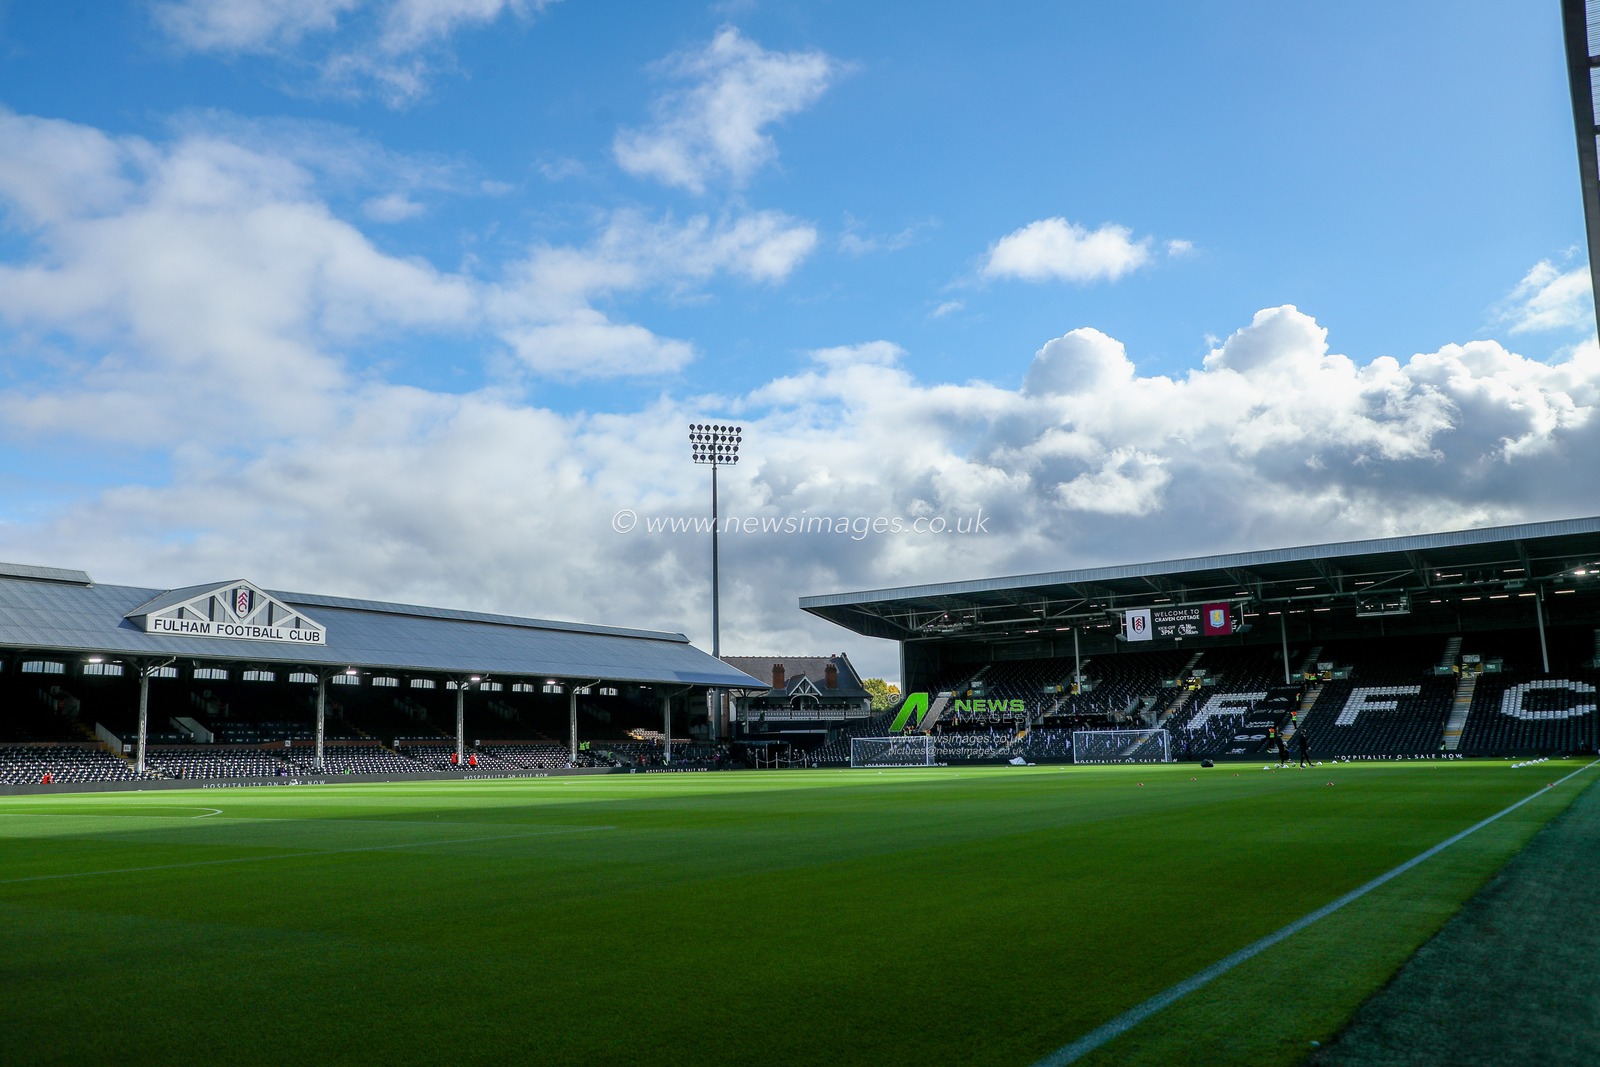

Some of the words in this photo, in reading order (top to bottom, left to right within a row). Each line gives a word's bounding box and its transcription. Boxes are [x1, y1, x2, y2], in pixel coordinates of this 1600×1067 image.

[154, 619, 210, 633] FULHAM
[216, 624, 283, 639] FOOTBALL
[289, 630, 320, 642] CLUB
[203, 781, 262, 789] HOSPITALITY
